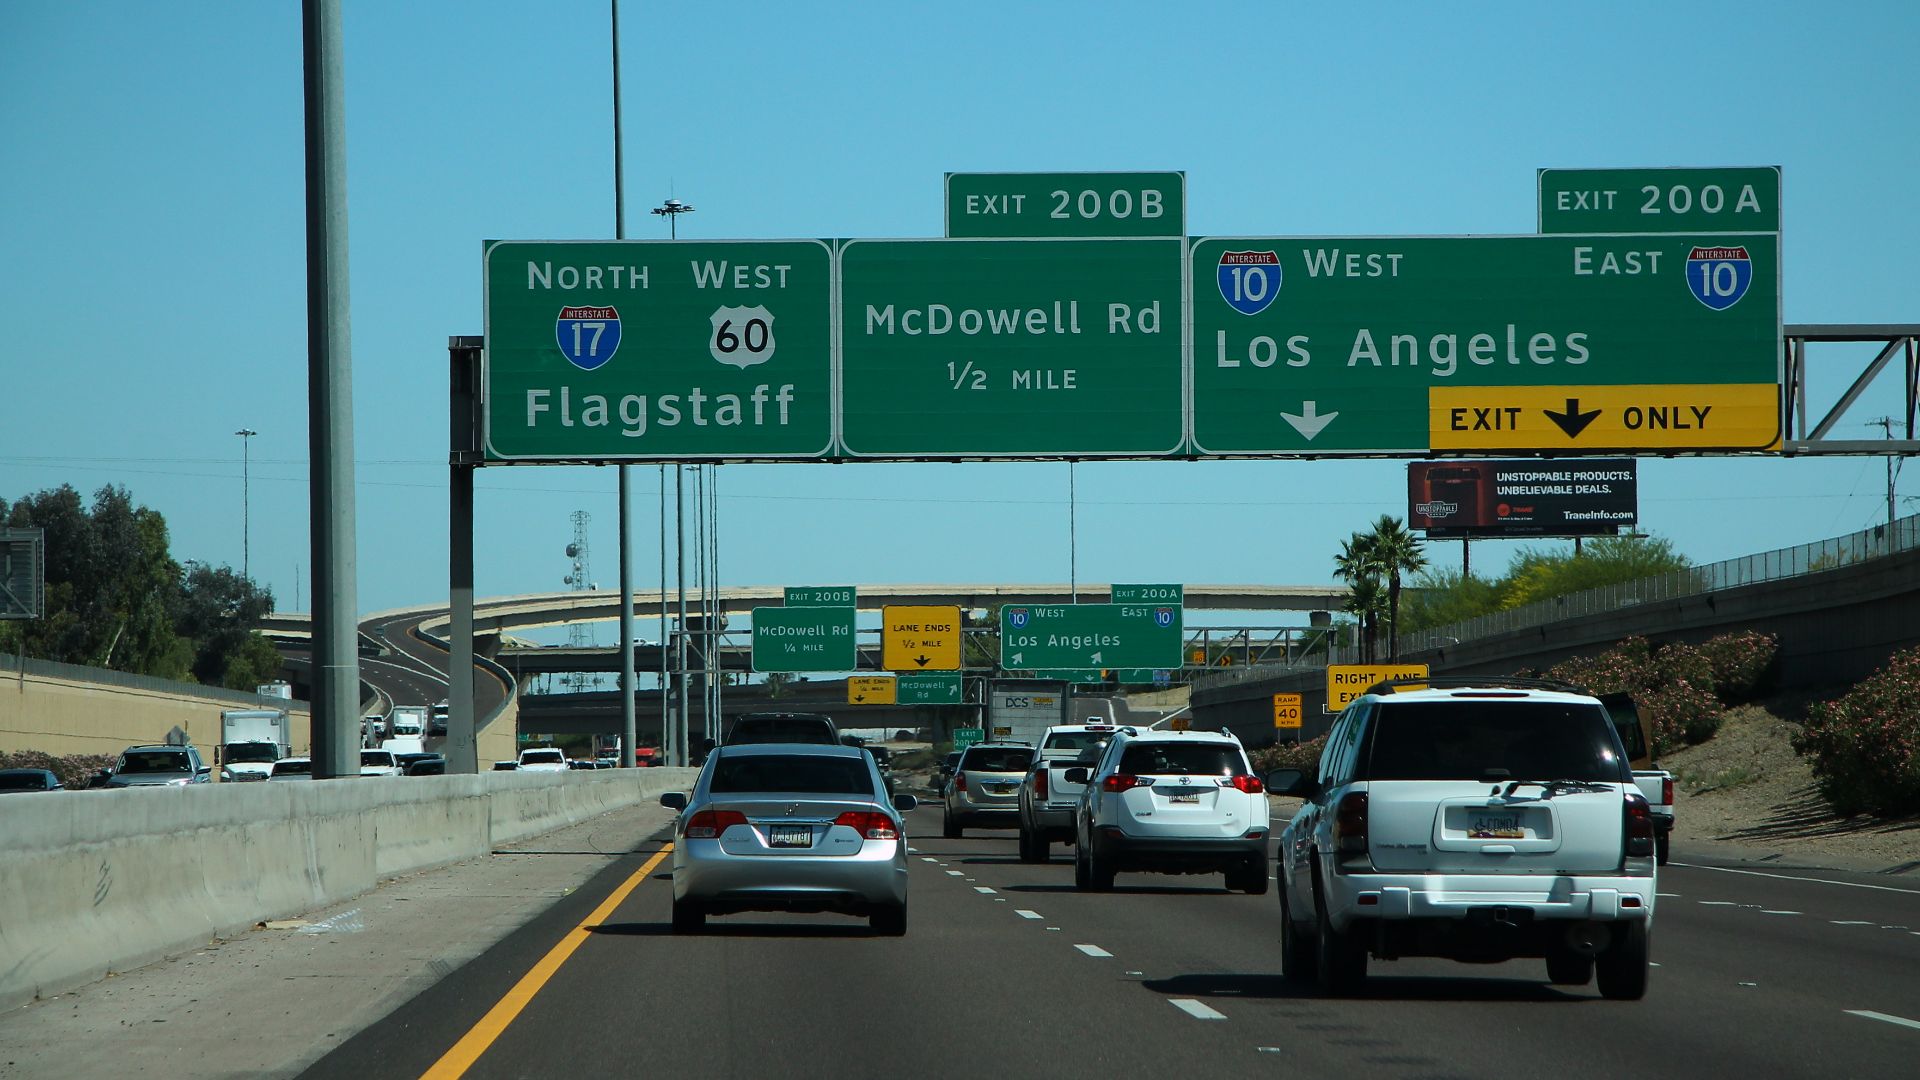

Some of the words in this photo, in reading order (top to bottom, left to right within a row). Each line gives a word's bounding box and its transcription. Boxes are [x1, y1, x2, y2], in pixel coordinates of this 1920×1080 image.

[967, 195, 1025, 214] EXIT
[1051, 190, 1163, 218] 200B
[1558, 191, 1617, 210] EXIT
[1641, 185, 1760, 213] 200A
[1228, 253, 1270, 263] INTERSTATE
[1697, 248, 1740, 258] INTERSTATE
[1303, 249, 1403, 277] WEST
[1575, 247, 1662, 274] EAST
[528, 262, 648, 289] NORTH
[691, 261, 791, 288] WEST
[1699, 260, 1737, 296] 10
[1232, 267, 1267, 301] 10
[565, 310, 611, 320] INTERSTATE
[867, 301, 1080, 334] McDowell
[1109, 301, 1159, 333] Rd
[572, 323, 605, 356] 17
[717, 319, 768, 353] 60
[1218, 330, 1310, 367] Los
[1347, 324, 1589, 376] Angeles
[948, 362, 986, 389] 1/2
[1013, 370, 1076, 389] MILE
[527, 384, 793, 437] Flagstaff
[1451, 408, 1521, 430] EXIT
[1624, 406, 1712, 429] ONLY
[1497, 472, 1571, 481] UNSTOPPABLE
[1574, 471, 1632, 480] PRODUCTS.
[1497, 486, 1572, 494] UNBELIEVABLE
[1576, 485, 1611, 493] DEALS.
[1564, 511, 1633, 519] TraneInfo.com
[816, 592, 849, 601] 200B
[1142, 589, 1177, 598] 200A
[1035, 608, 1064, 617] WEST
[1122, 608, 1147, 616] EAST
[1159, 613, 1169, 623] 10
[1014, 614, 1024, 624] 10
[760, 625, 824, 636] McDowell
[833, 626, 848, 635] Rd
[1009, 635, 1037, 646] Los
[1048, 634, 1120, 649] Angeles
[1336, 674, 1377, 685] RIGHT
[1005, 697, 1029, 709] DCS
[1340, 692, 1365, 703] EX
[1279, 709, 1297, 718] 40
